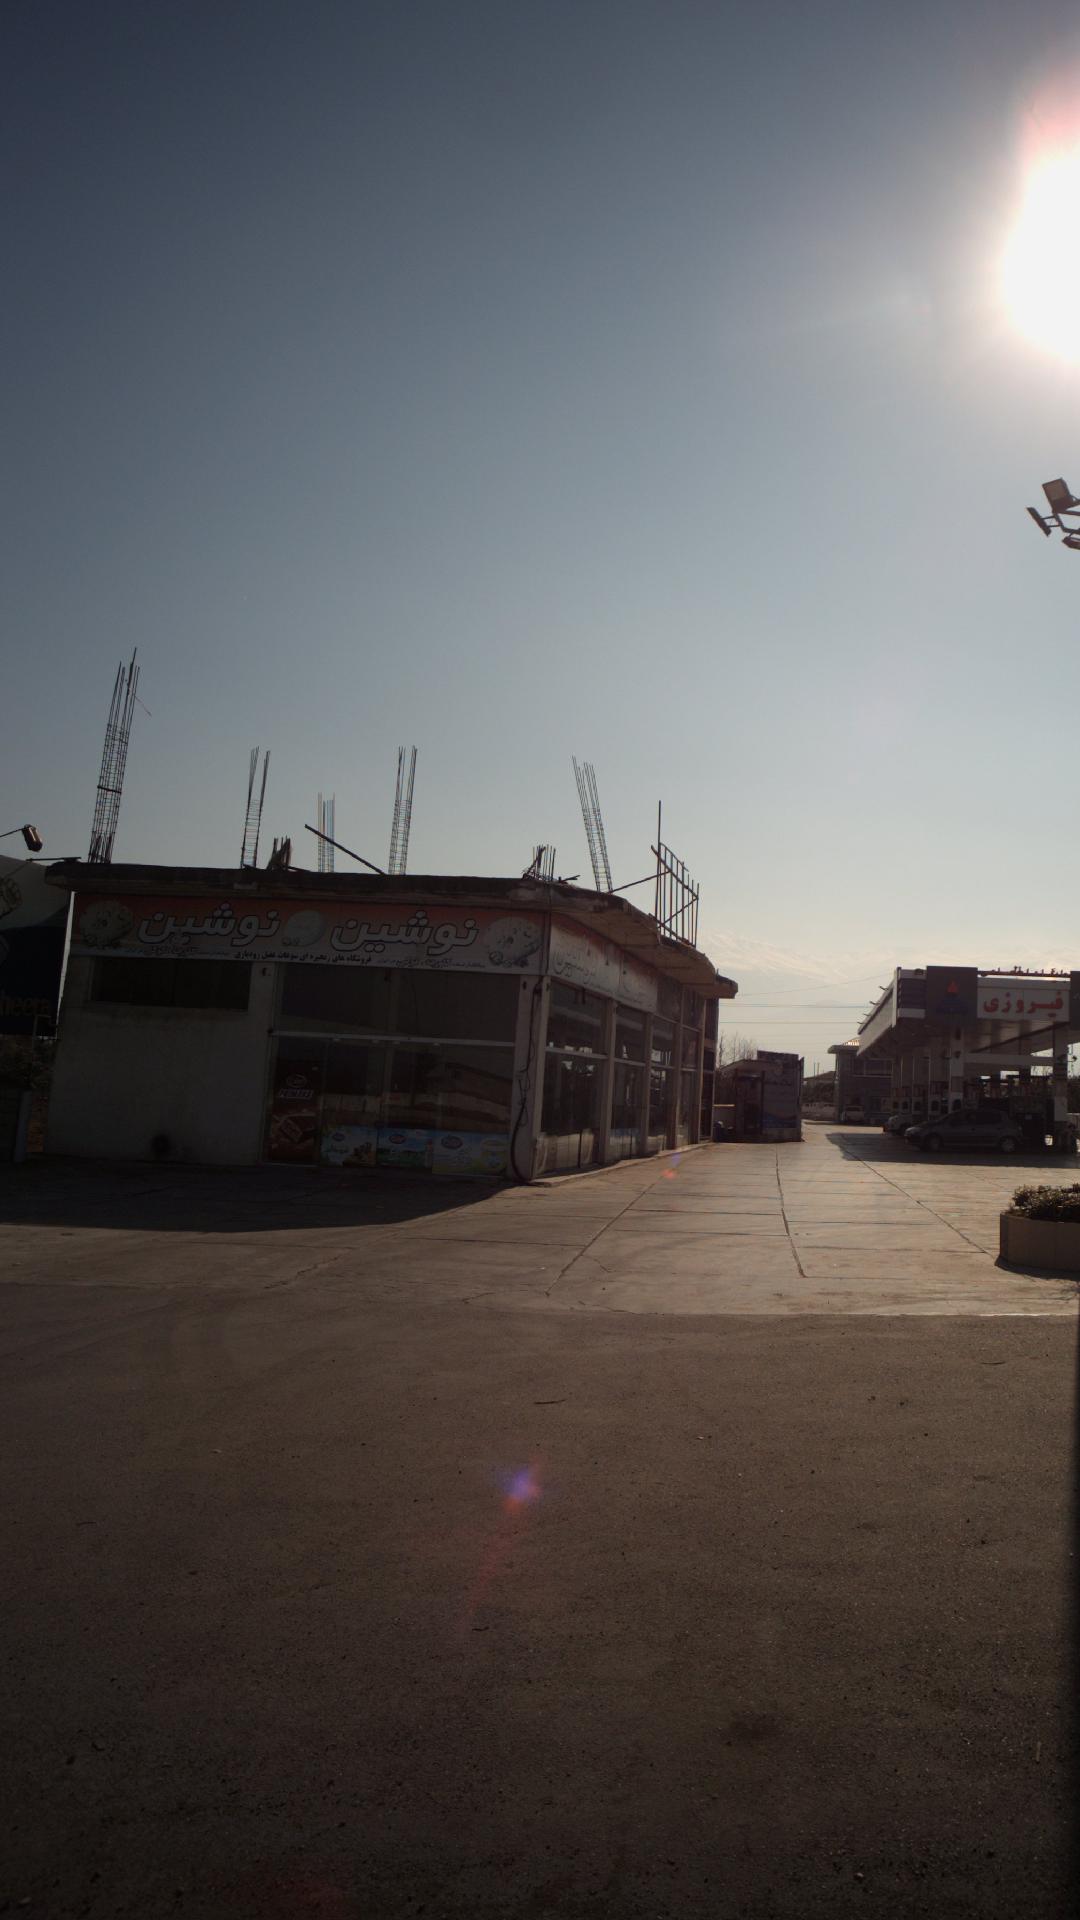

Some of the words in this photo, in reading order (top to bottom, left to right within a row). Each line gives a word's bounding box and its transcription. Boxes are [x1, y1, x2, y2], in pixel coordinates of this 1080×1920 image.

[138, 902, 281, 947] نوشین
[330, 909, 480, 956] نوشین
[983, 991, 1065, 1018] فیروزی
